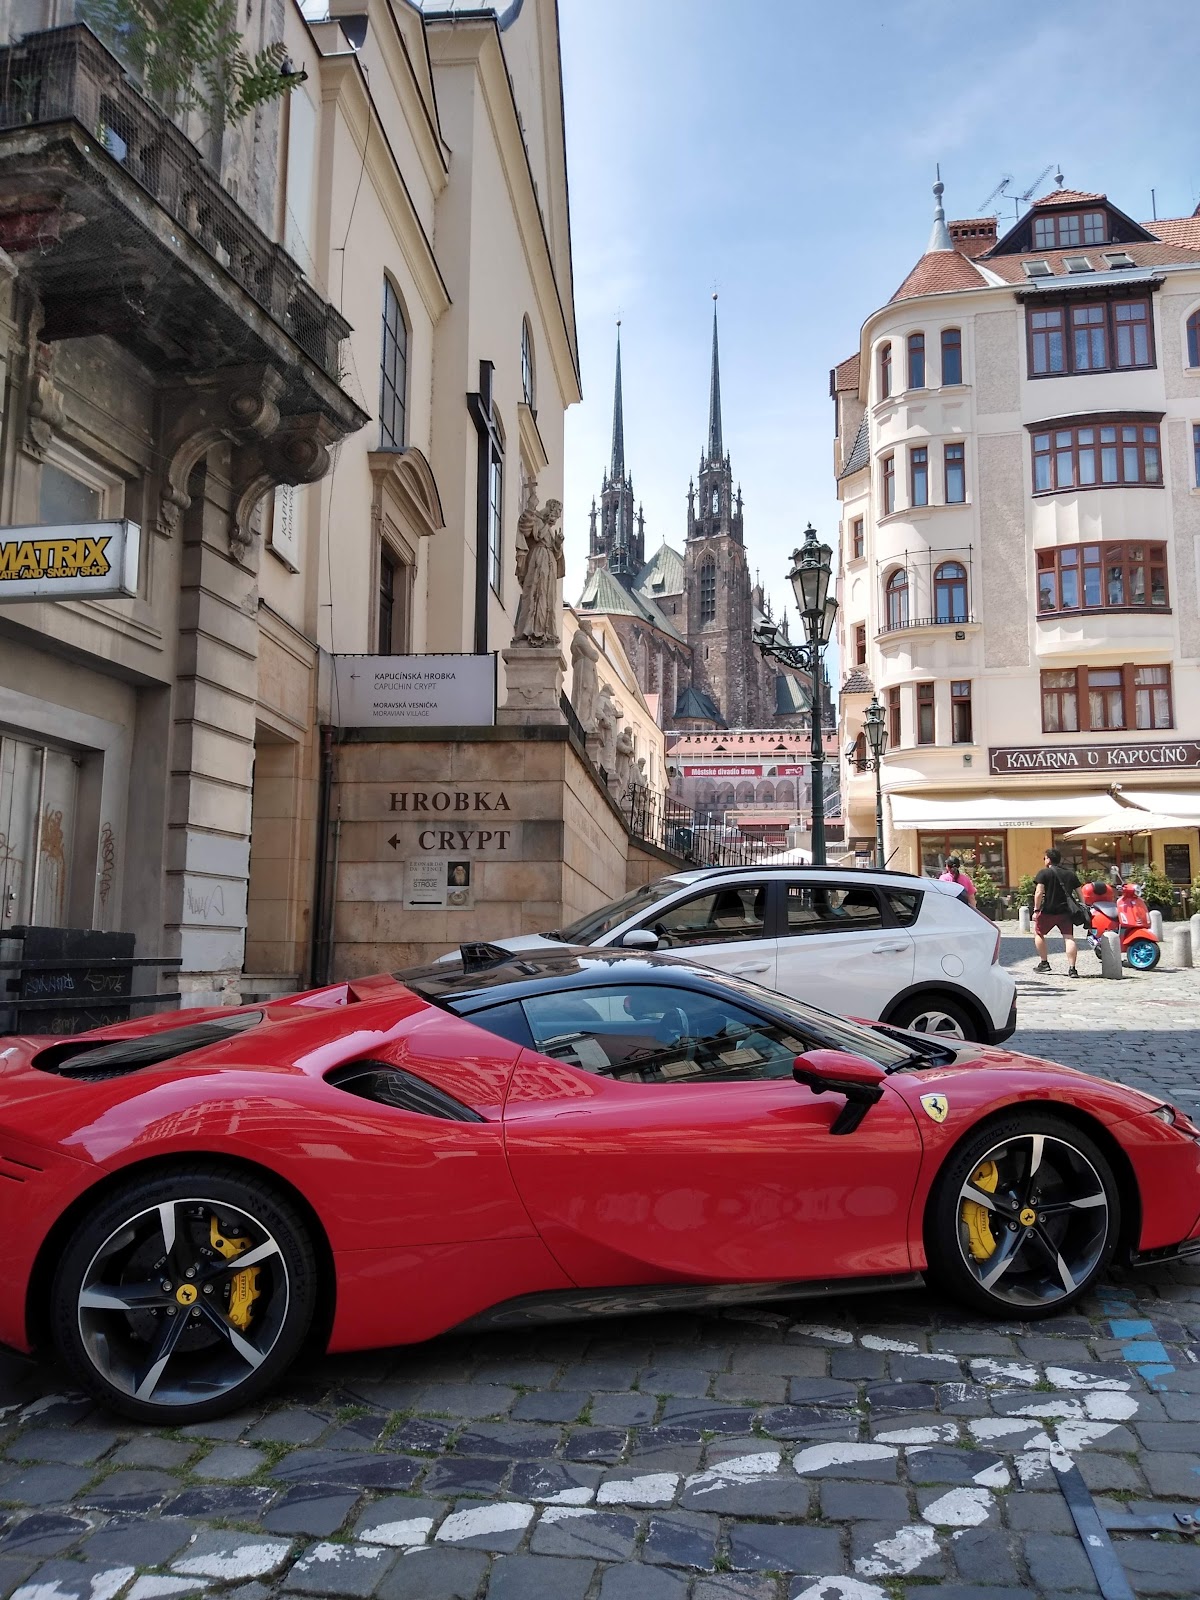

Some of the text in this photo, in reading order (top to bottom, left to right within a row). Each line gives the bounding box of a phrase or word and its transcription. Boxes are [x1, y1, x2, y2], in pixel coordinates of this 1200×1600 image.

[281, 484, 289, 536] KAPUC
[0, 537, 112, 570] MATRIX
[21, 567, 44, 579] AND
[46, 565, 78, 578] SNOW
[80, 565, 110, 577] SHOP
[374, 671, 456, 680] KAPUCÍNSKÁ HROBKA
[373, 682, 437, 691] CAPUCHIN CRYPT
[373, 701, 438, 709] MORAVSKÁ VESNIČKA
[1006, 746, 1187, 769] KAVÁRNA U KAPUCÍNŮ
[388, 791, 511, 812] HROBKA
[418, 830, 511, 850] CRYPT
